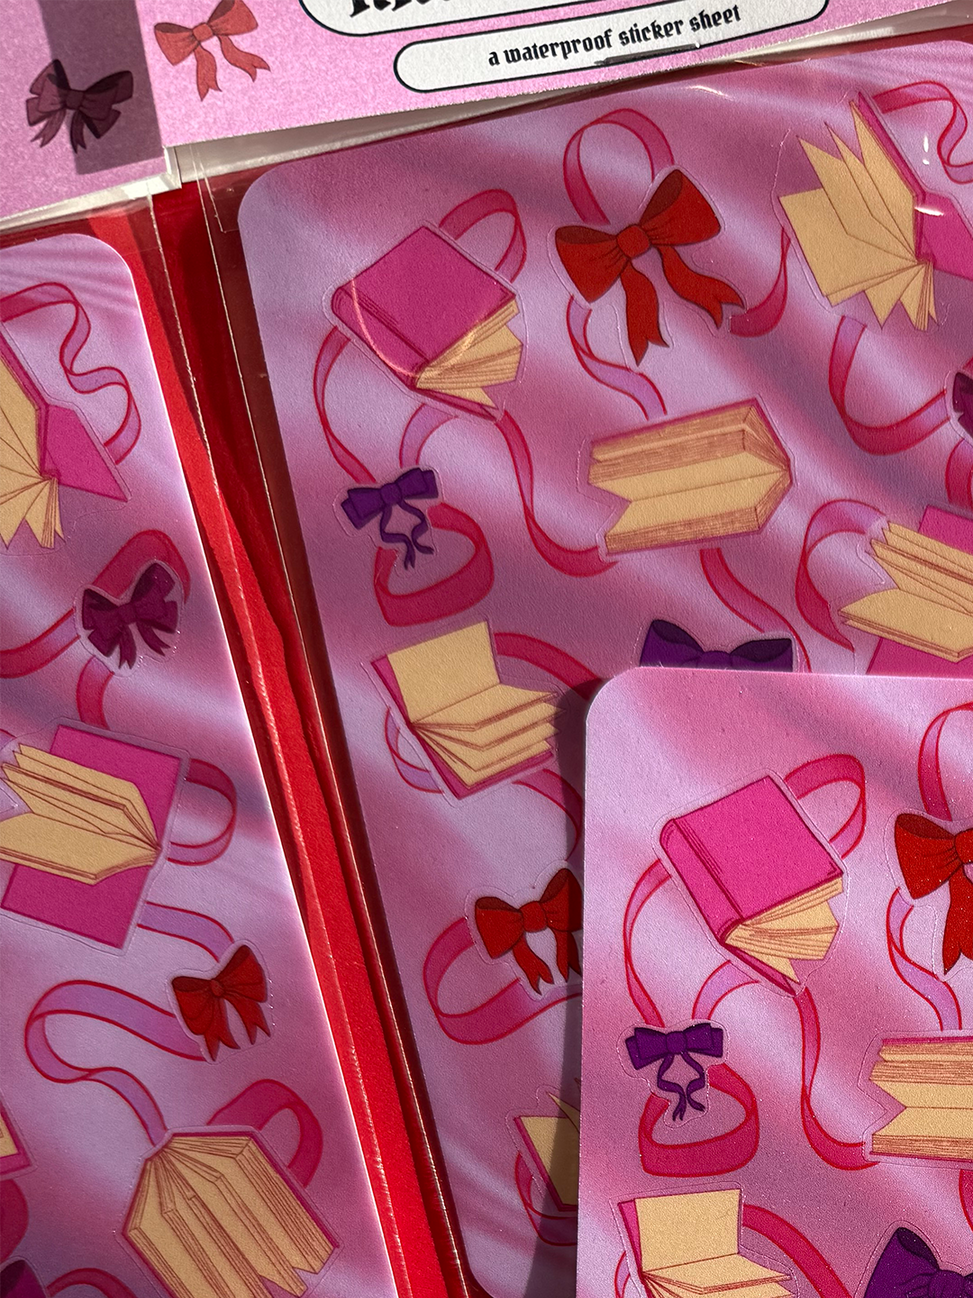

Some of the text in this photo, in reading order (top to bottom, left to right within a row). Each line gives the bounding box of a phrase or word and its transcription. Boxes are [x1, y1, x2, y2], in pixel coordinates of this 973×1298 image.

[488, 4, 742, 66] a waterproof sticker sheet
